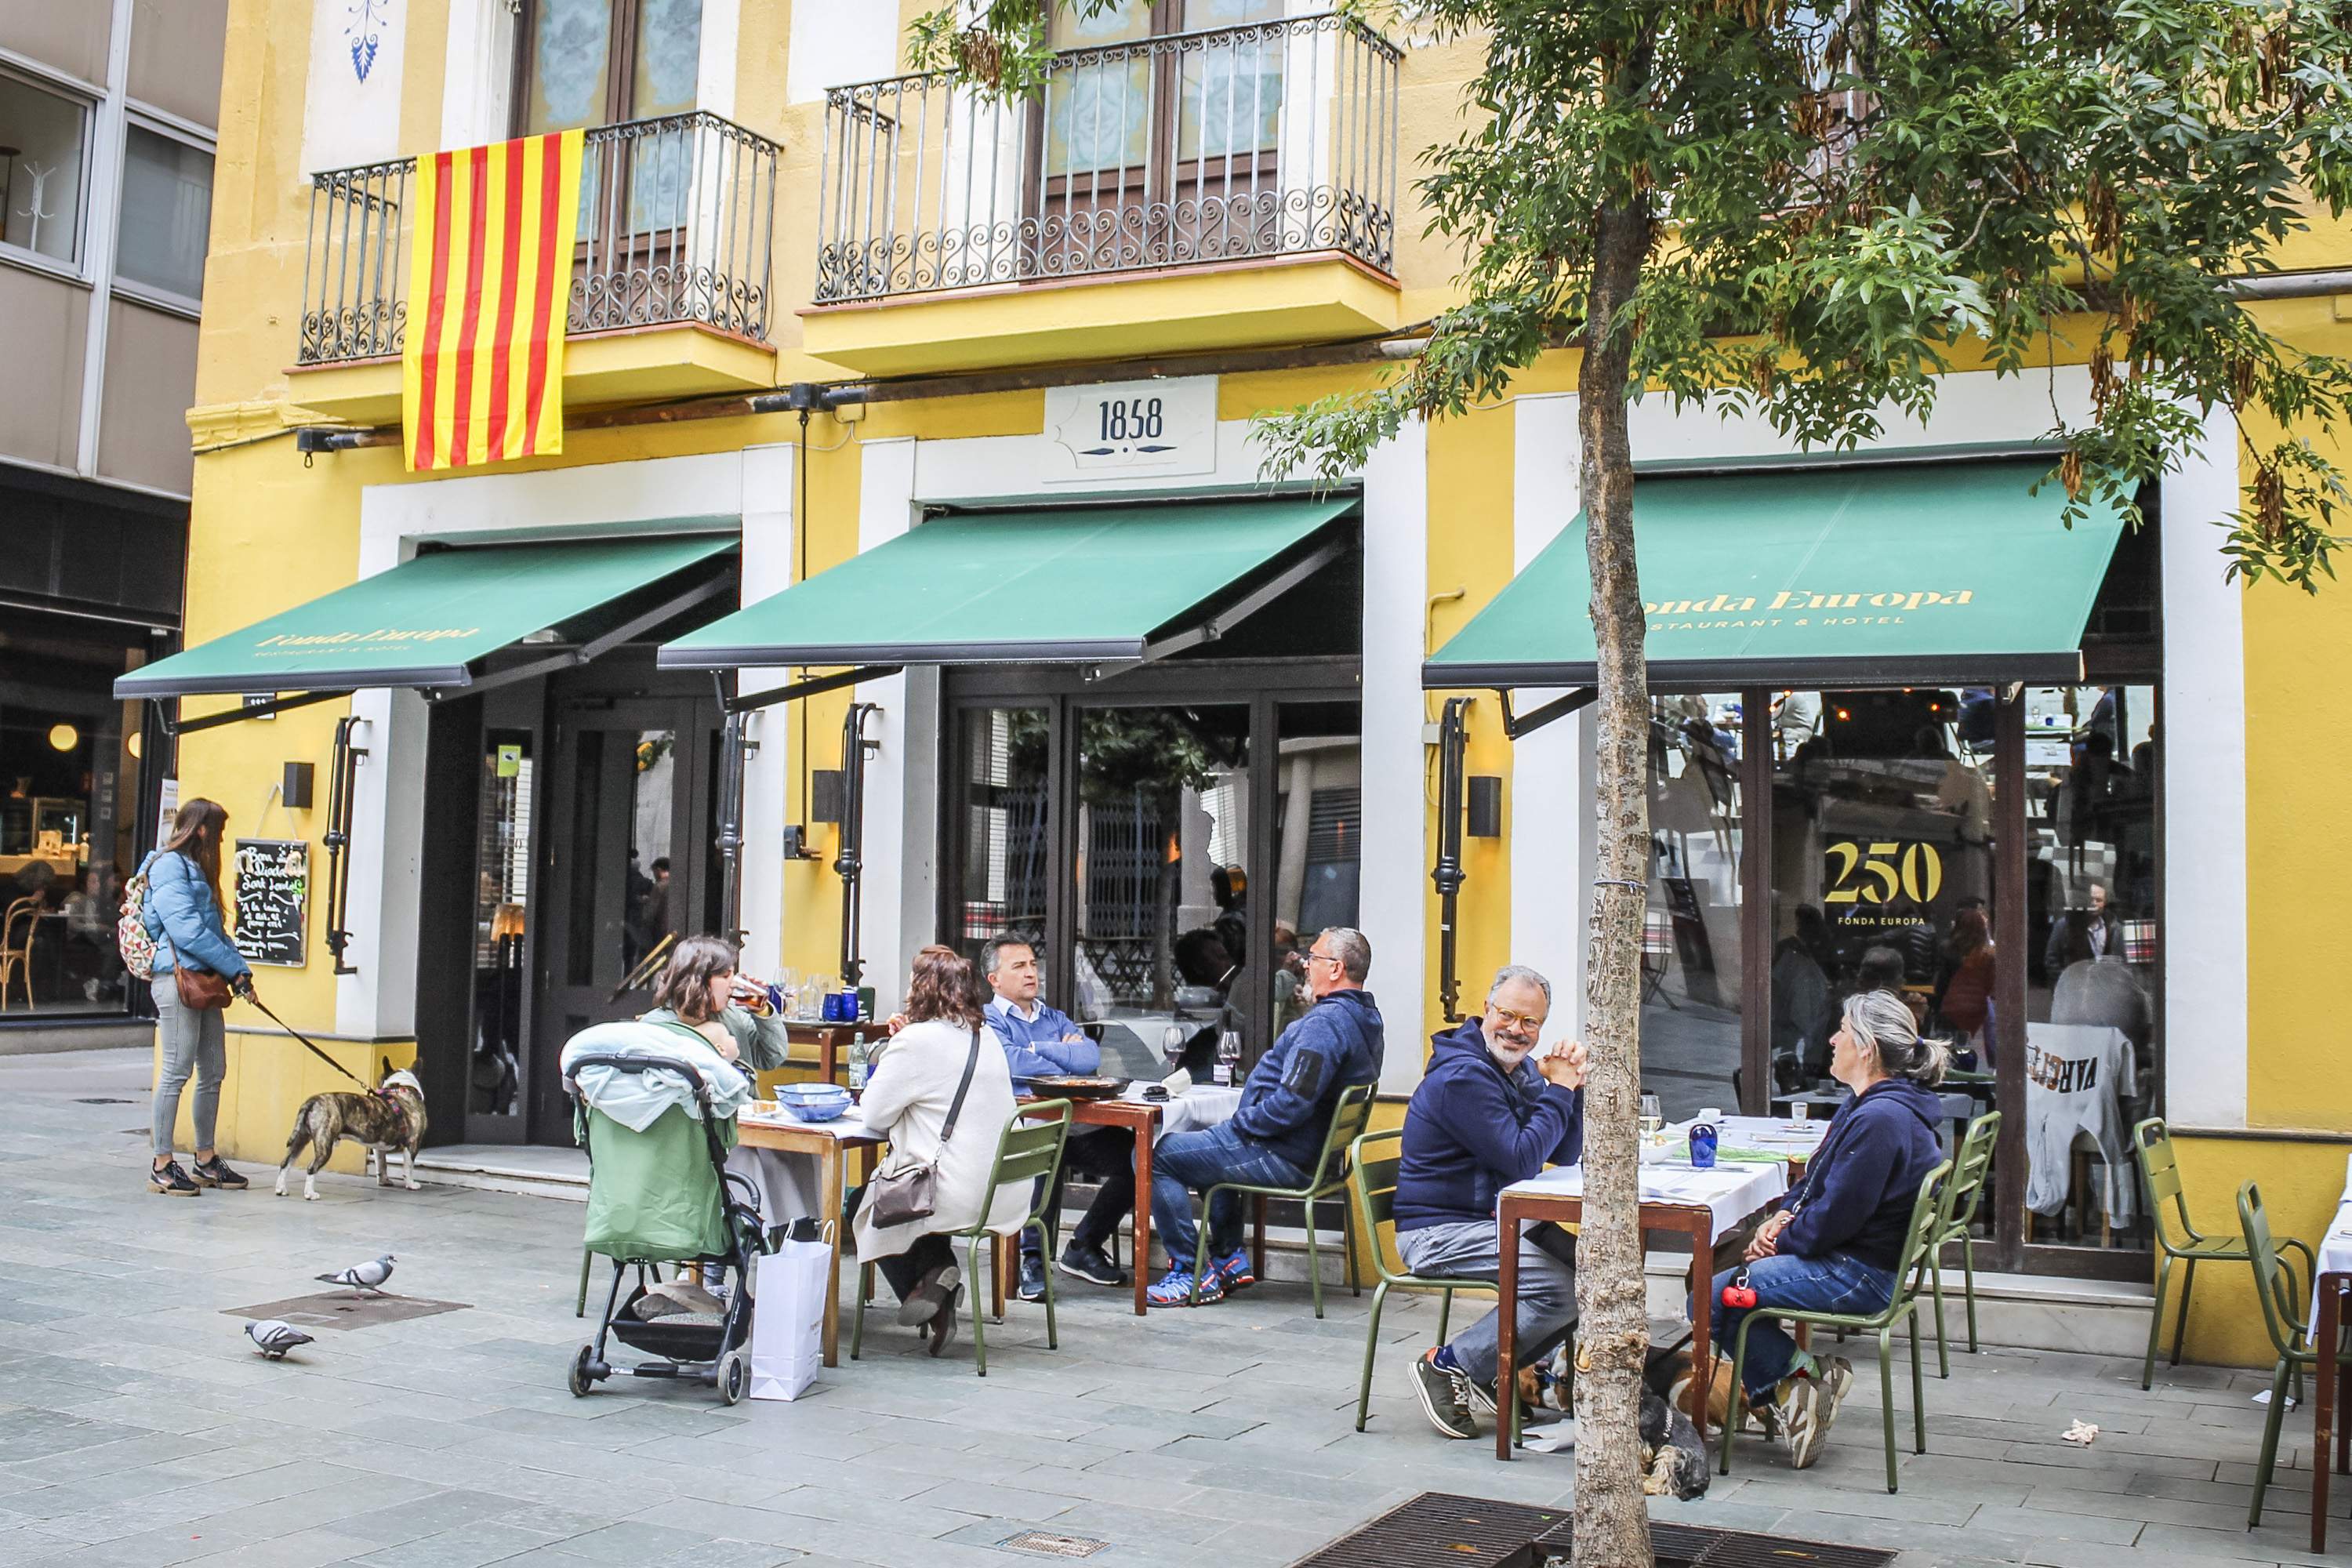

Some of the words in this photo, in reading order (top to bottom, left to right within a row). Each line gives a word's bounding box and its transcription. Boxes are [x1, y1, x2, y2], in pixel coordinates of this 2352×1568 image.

[1099, 397, 1163, 441] 1858
[1644, 594, 1756, 615] onda
[1767, 590, 1973, 609] Europa
[1650, 619, 1783, 630] STAURANT
[1824, 615, 1905, 626] HOTEL
[1824, 842, 1943, 903] 250
[1881, 917, 1926, 926] EUROPA
